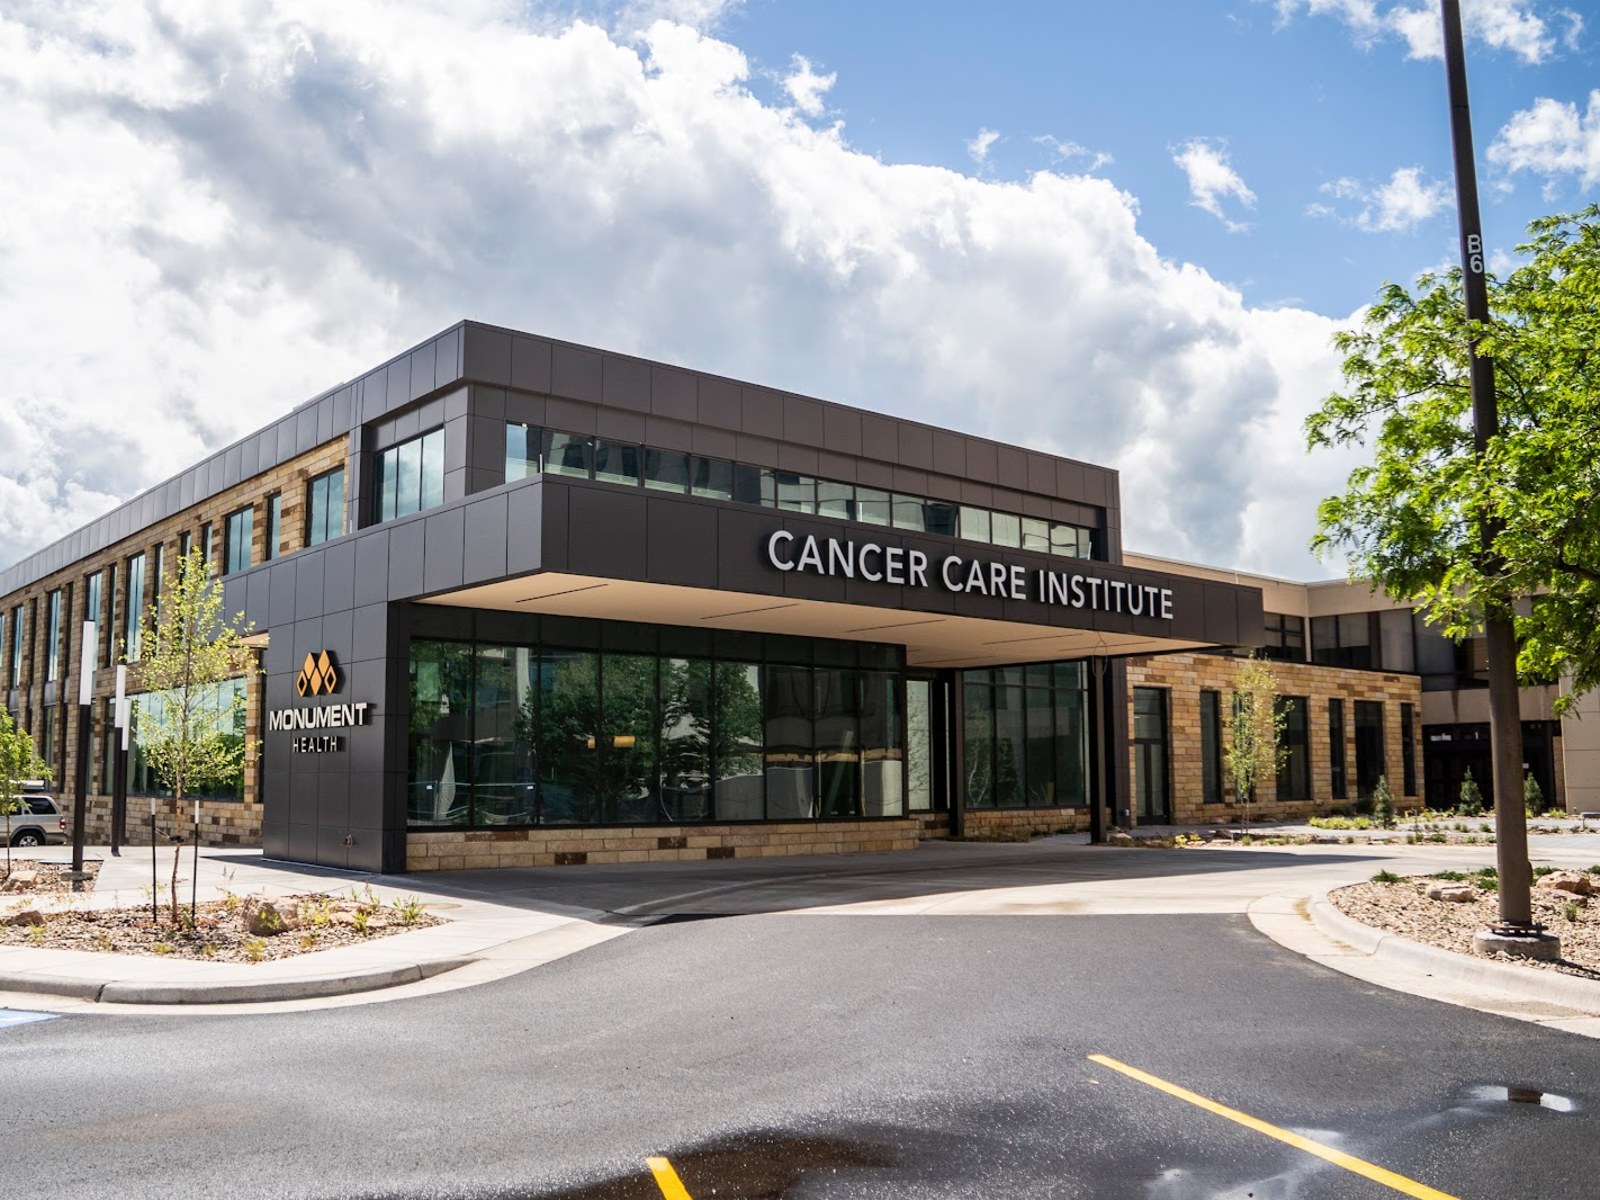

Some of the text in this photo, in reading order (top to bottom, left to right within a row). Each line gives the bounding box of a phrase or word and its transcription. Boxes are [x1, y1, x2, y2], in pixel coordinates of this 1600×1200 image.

[768, 530, 1174, 620] CANCER CARE INSTITUTE
[269, 702, 367, 731] MONUMENT
[293, 736, 337, 753] HEALTH
